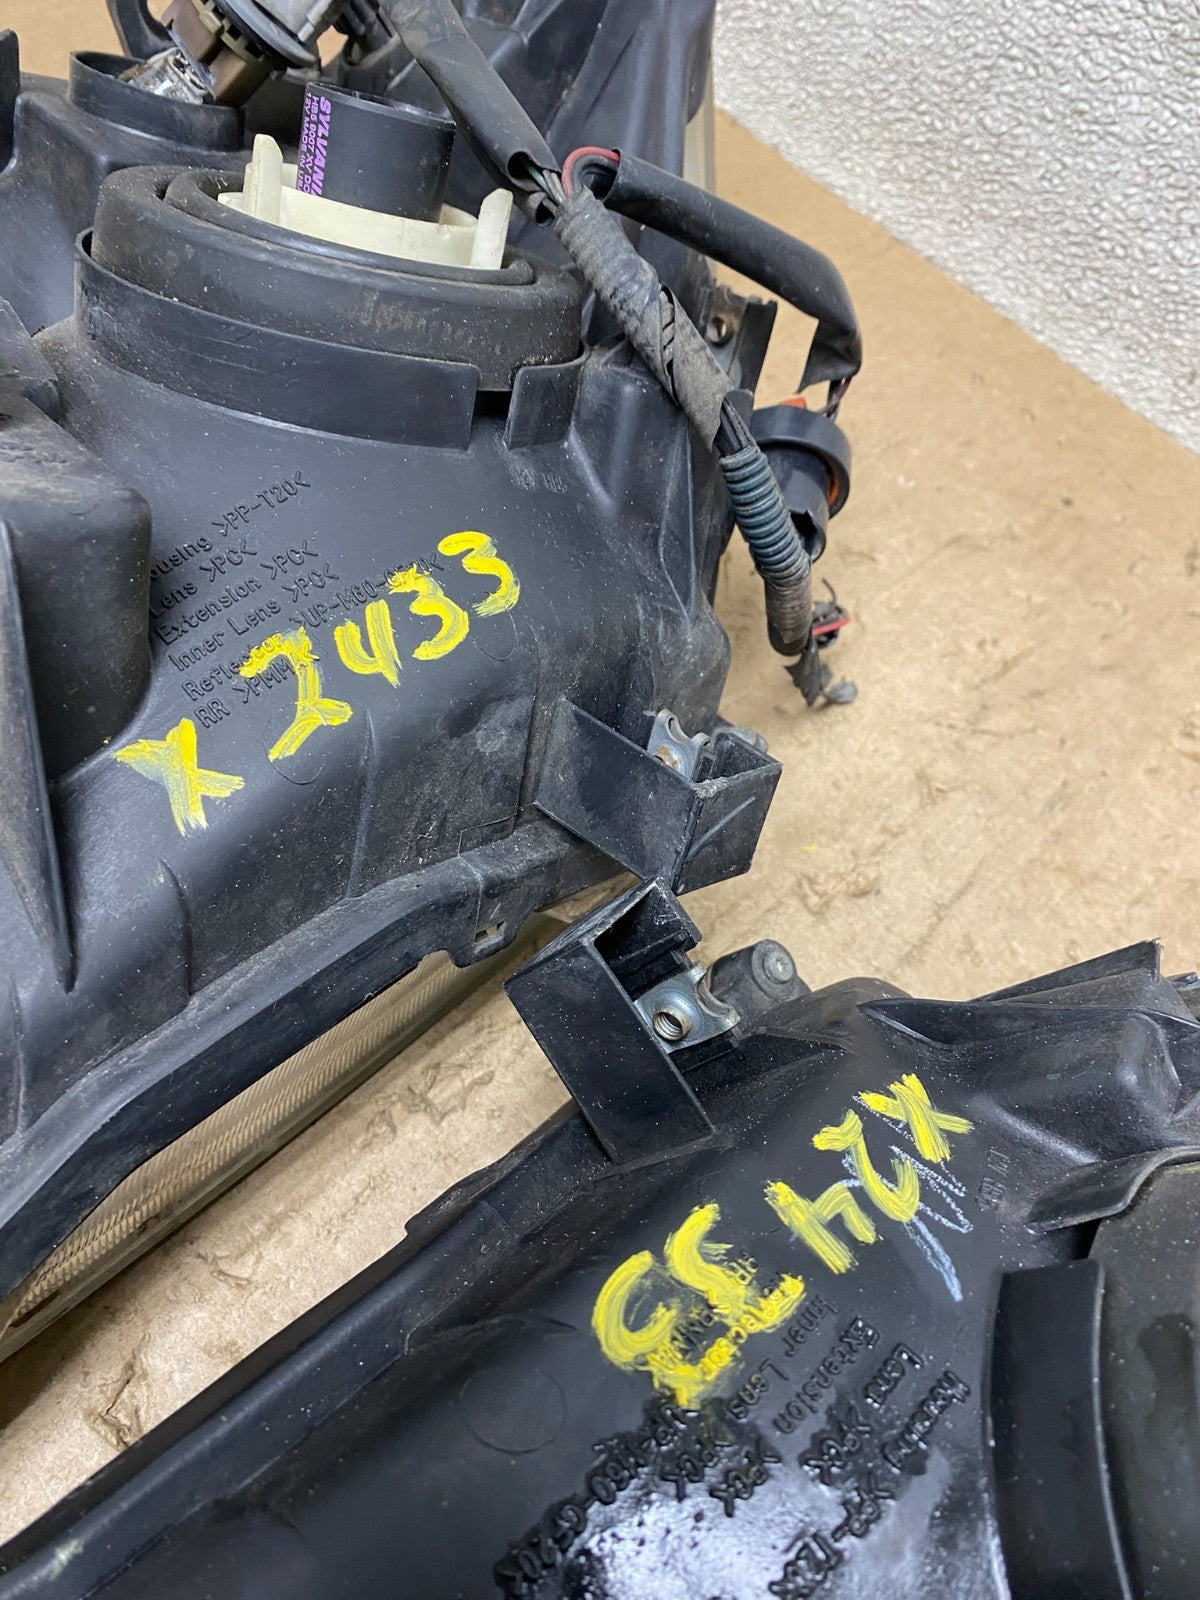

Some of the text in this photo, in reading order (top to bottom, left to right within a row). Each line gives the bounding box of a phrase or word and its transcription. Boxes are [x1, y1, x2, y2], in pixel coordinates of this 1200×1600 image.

[301, 116, 309, 152] MADE
[308, 123, 317, 154] 9007
[310, 96, 331, 196] SYLVANI
[299, 154, 306, 168] IN
[303, 174, 312, 193] DO
[305, 152, 314, 173] XV
[150, 537, 213, 582] ousing
[155, 577, 262, 645] Extension
[168, 630, 225, 673] Inner
[227, 599, 281, 635] Lens
[181, 633, 283, 701] Reflector
[193, 699, 231, 729] RR
[784, 1296, 838, 1359] Inner
[727, 1359, 790, 1421] Lens
[772, 1317, 881, 1436] Extension
